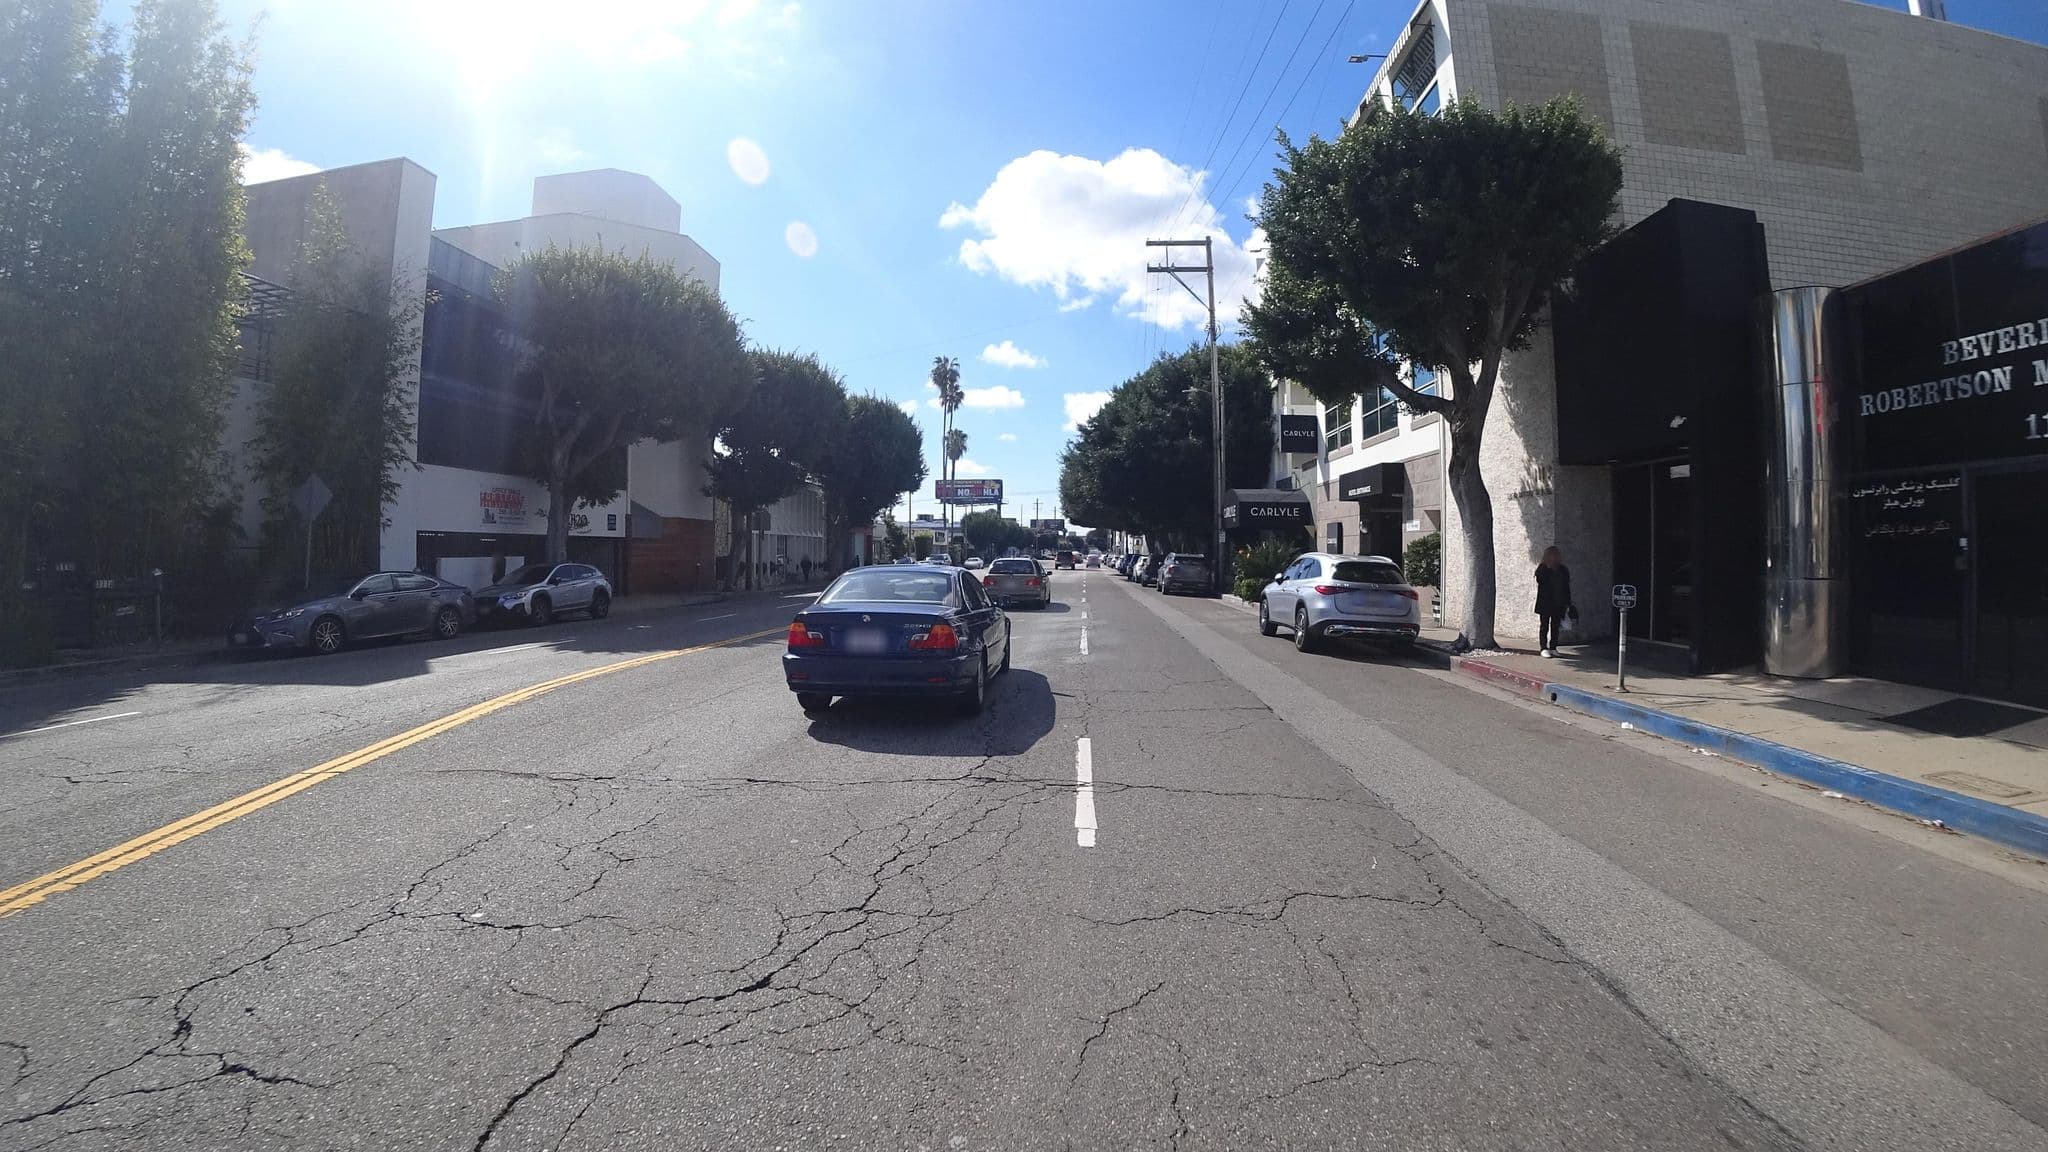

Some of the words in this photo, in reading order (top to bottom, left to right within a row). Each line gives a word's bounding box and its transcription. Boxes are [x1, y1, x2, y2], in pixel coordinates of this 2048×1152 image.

[1859, 365, 2013, 417] ROBERTSON
[958, 488, 970, 496] NO
[983, 488, 999, 496] HLA
[1250, 507, 1300, 517] CARLYLE
